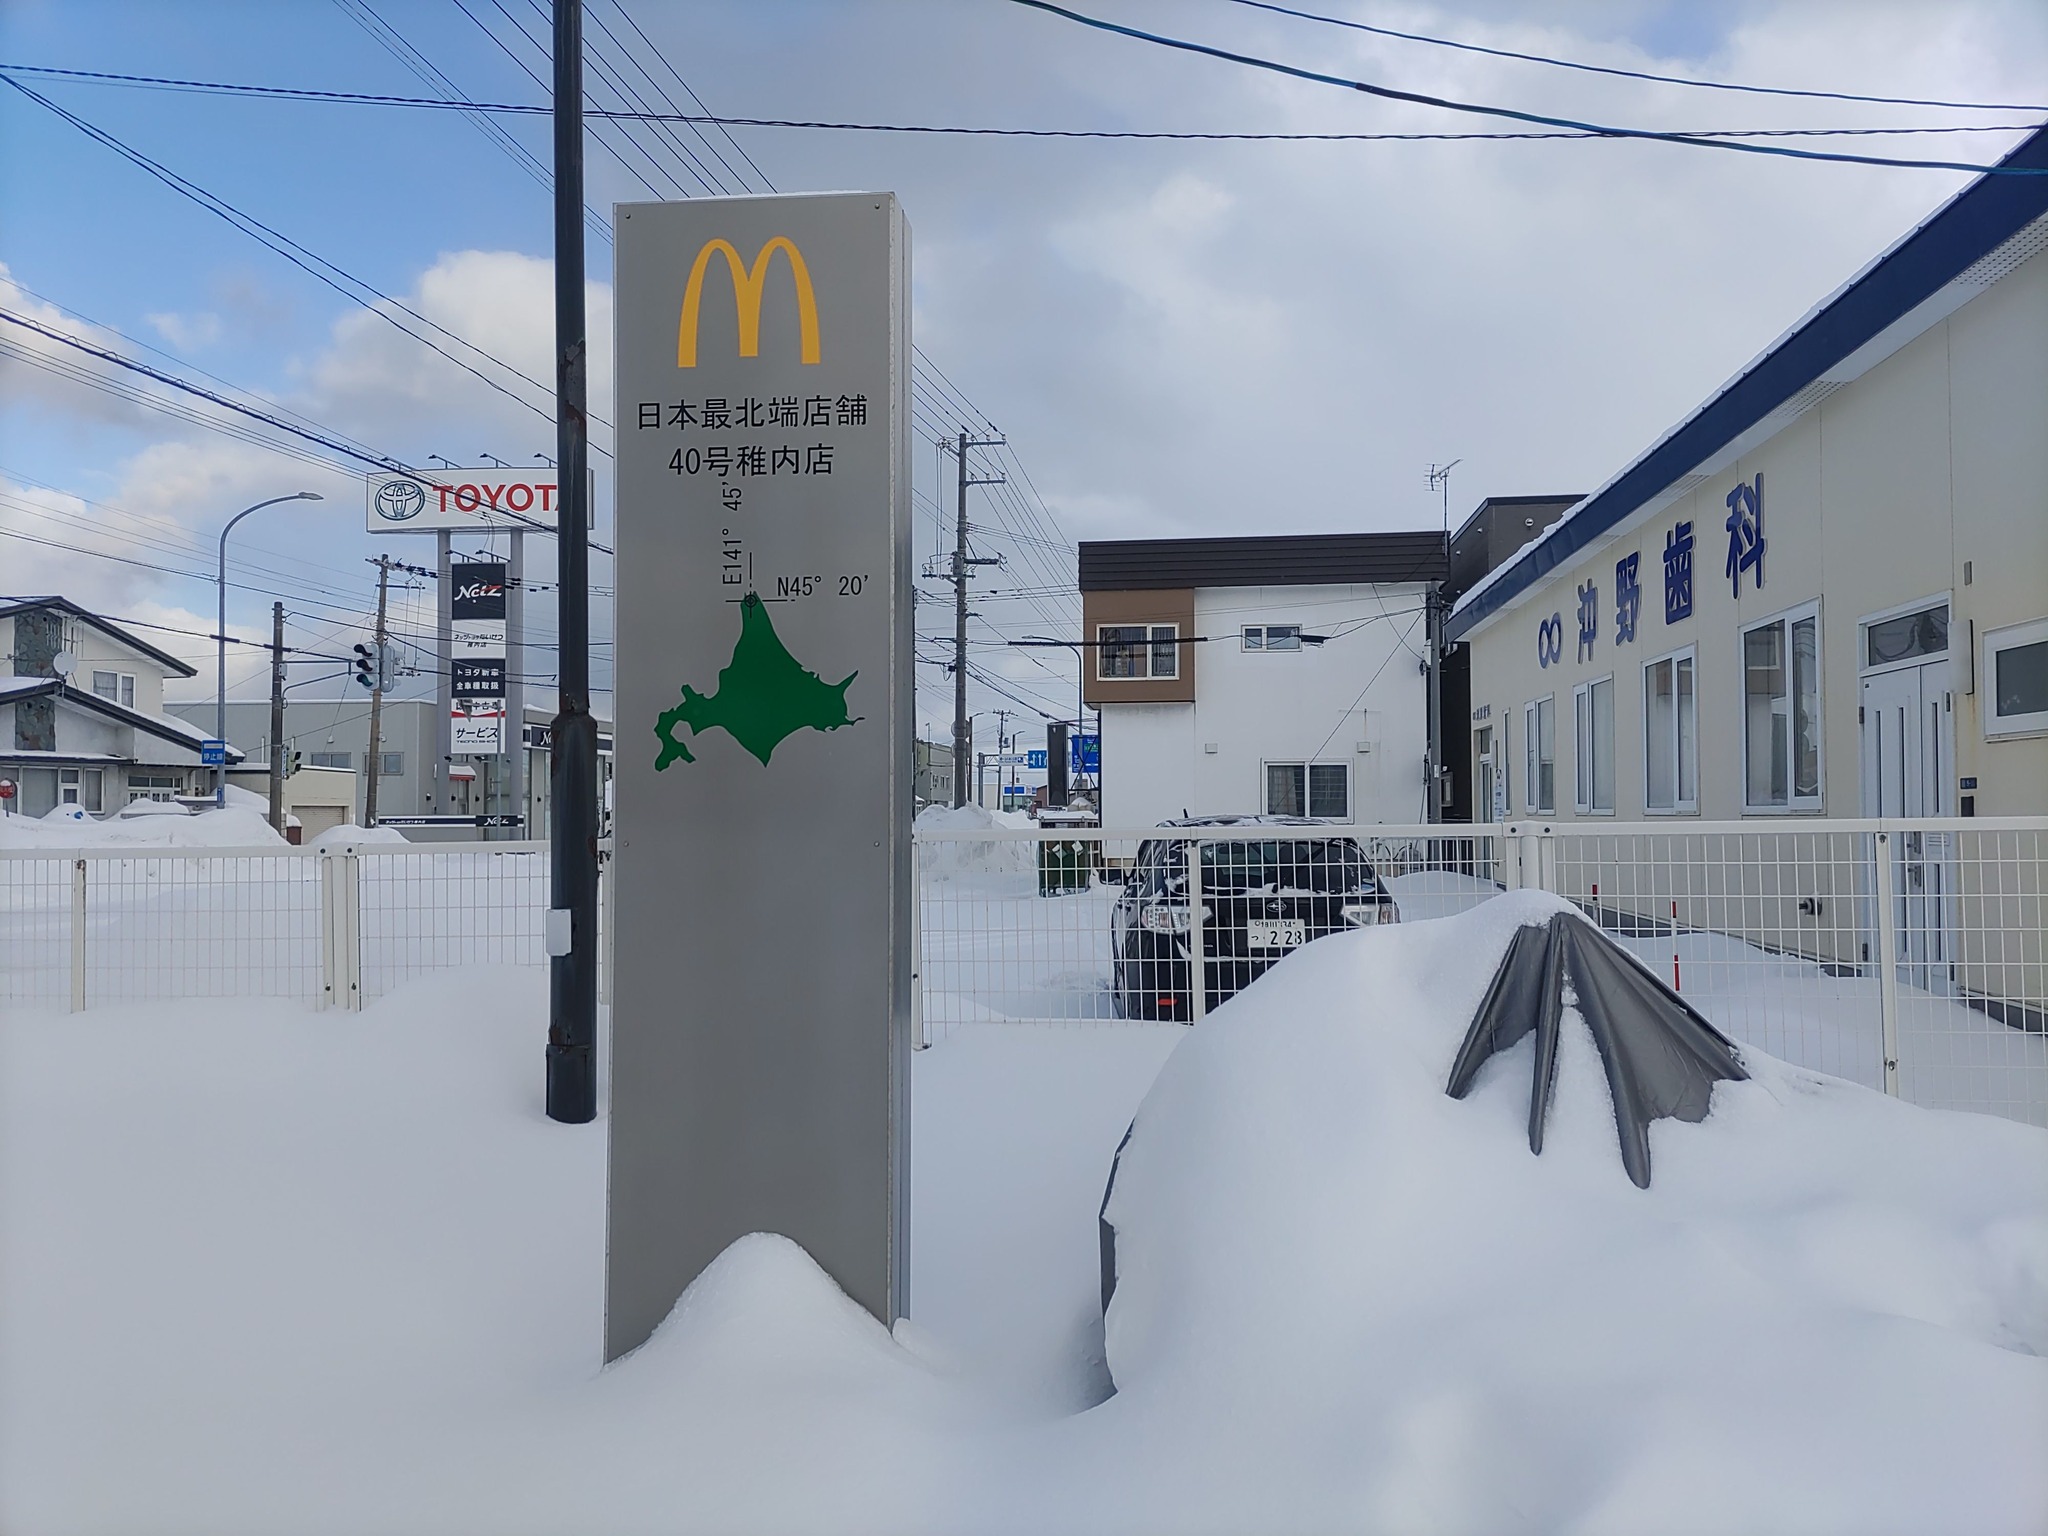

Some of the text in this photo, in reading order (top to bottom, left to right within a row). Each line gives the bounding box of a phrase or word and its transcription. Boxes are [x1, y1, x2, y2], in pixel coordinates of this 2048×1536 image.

[637, 393, 868, 431] 日本最北端店舗
[668, 443, 834, 477] 40号稚内店
[432, 483, 559, 512] TOYOT
[456, 727, 498, 739] サービス
